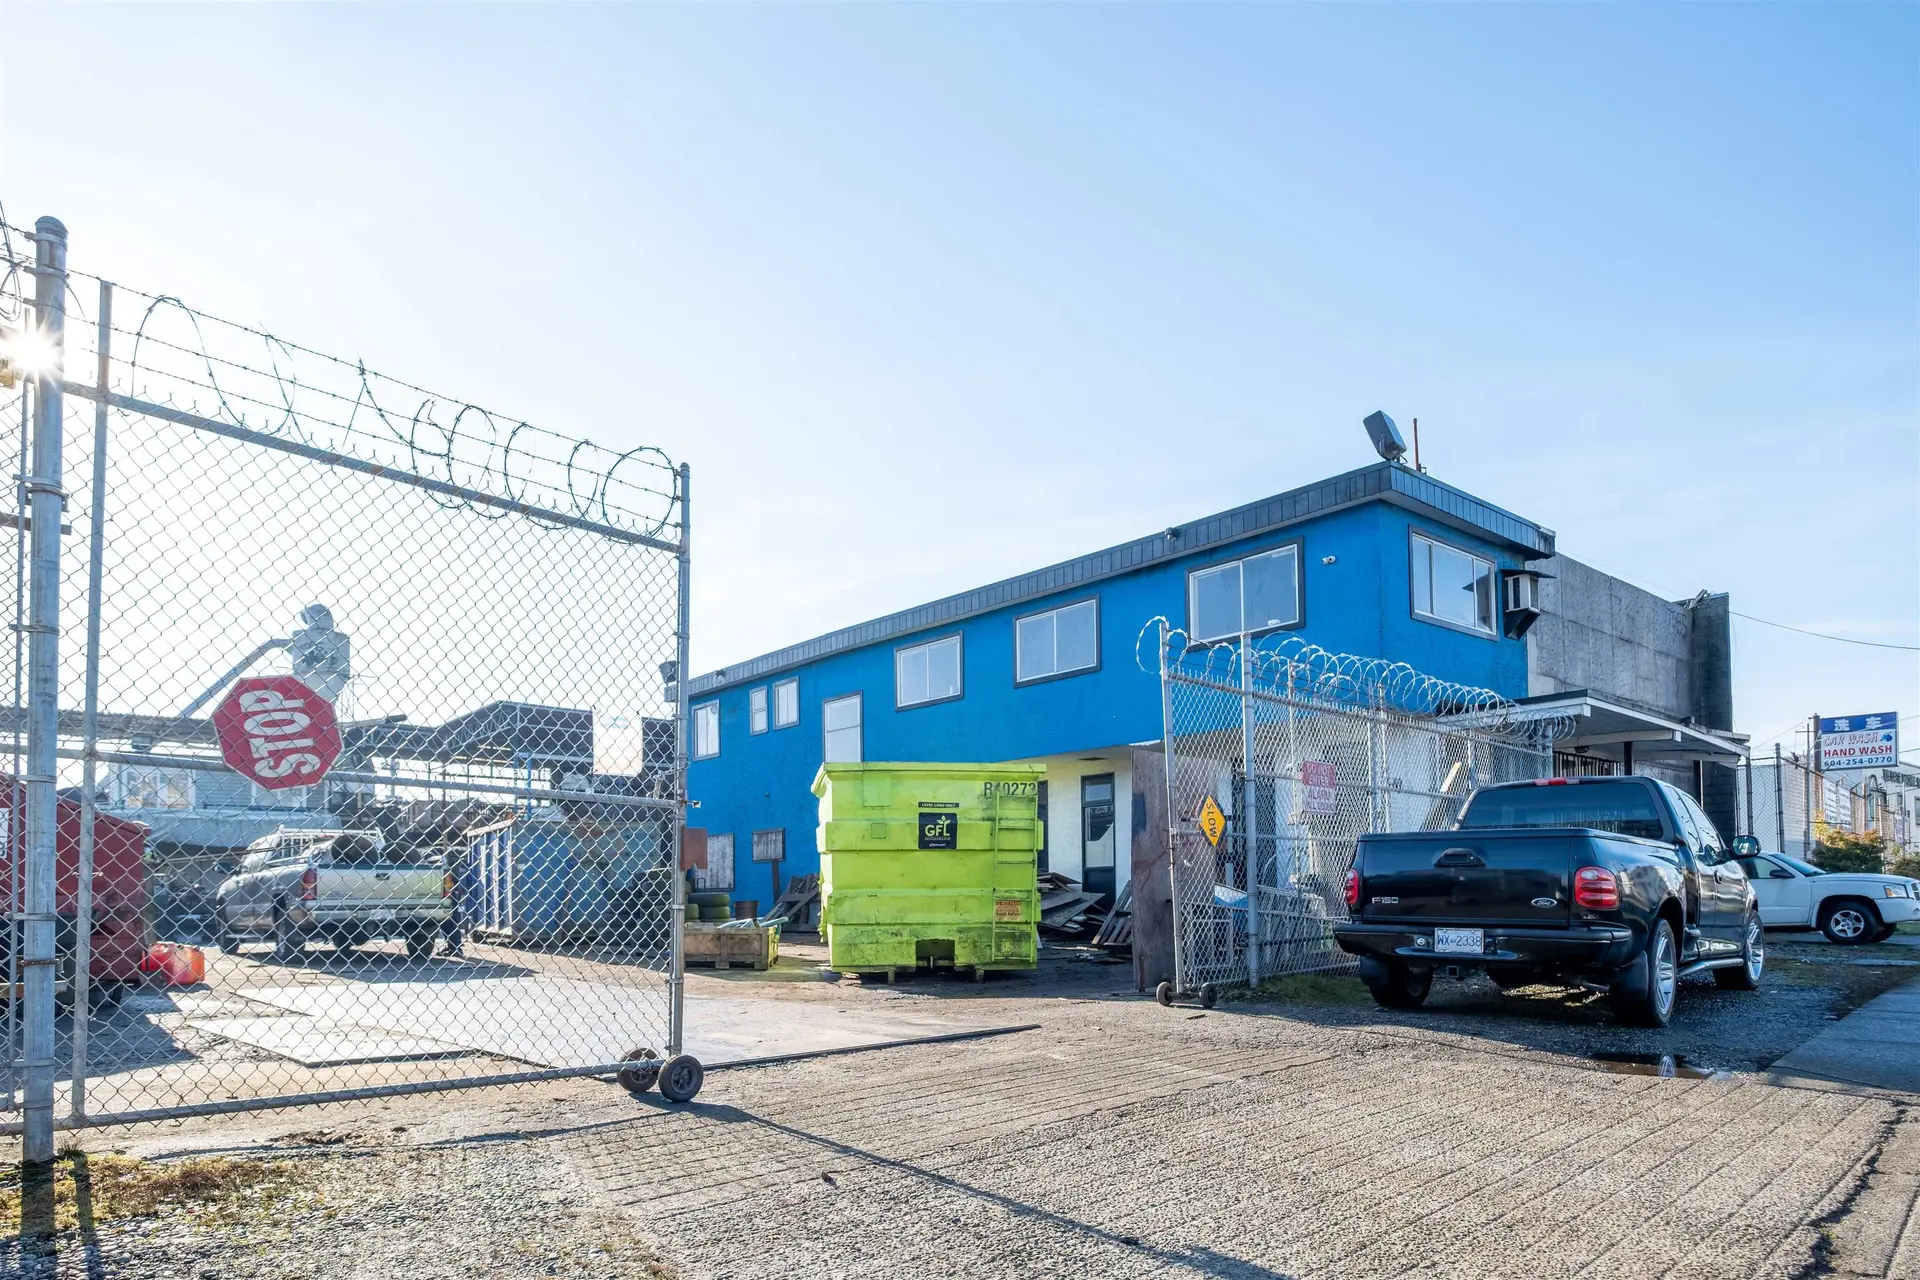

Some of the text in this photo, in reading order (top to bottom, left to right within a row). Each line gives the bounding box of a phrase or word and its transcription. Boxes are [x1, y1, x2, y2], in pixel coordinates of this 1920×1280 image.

[239, 690, 321, 778] STOP
[1824, 732, 1879, 747] CAR WASH
[1824, 745, 1892, 758] HAND WASH
[1824, 756, 1892, 767] 604-254-0770
[1206, 803, 1218, 838] SLOW
[925, 820, 951, 837] GFL
[1456, 935, 1481, 947] 2338
